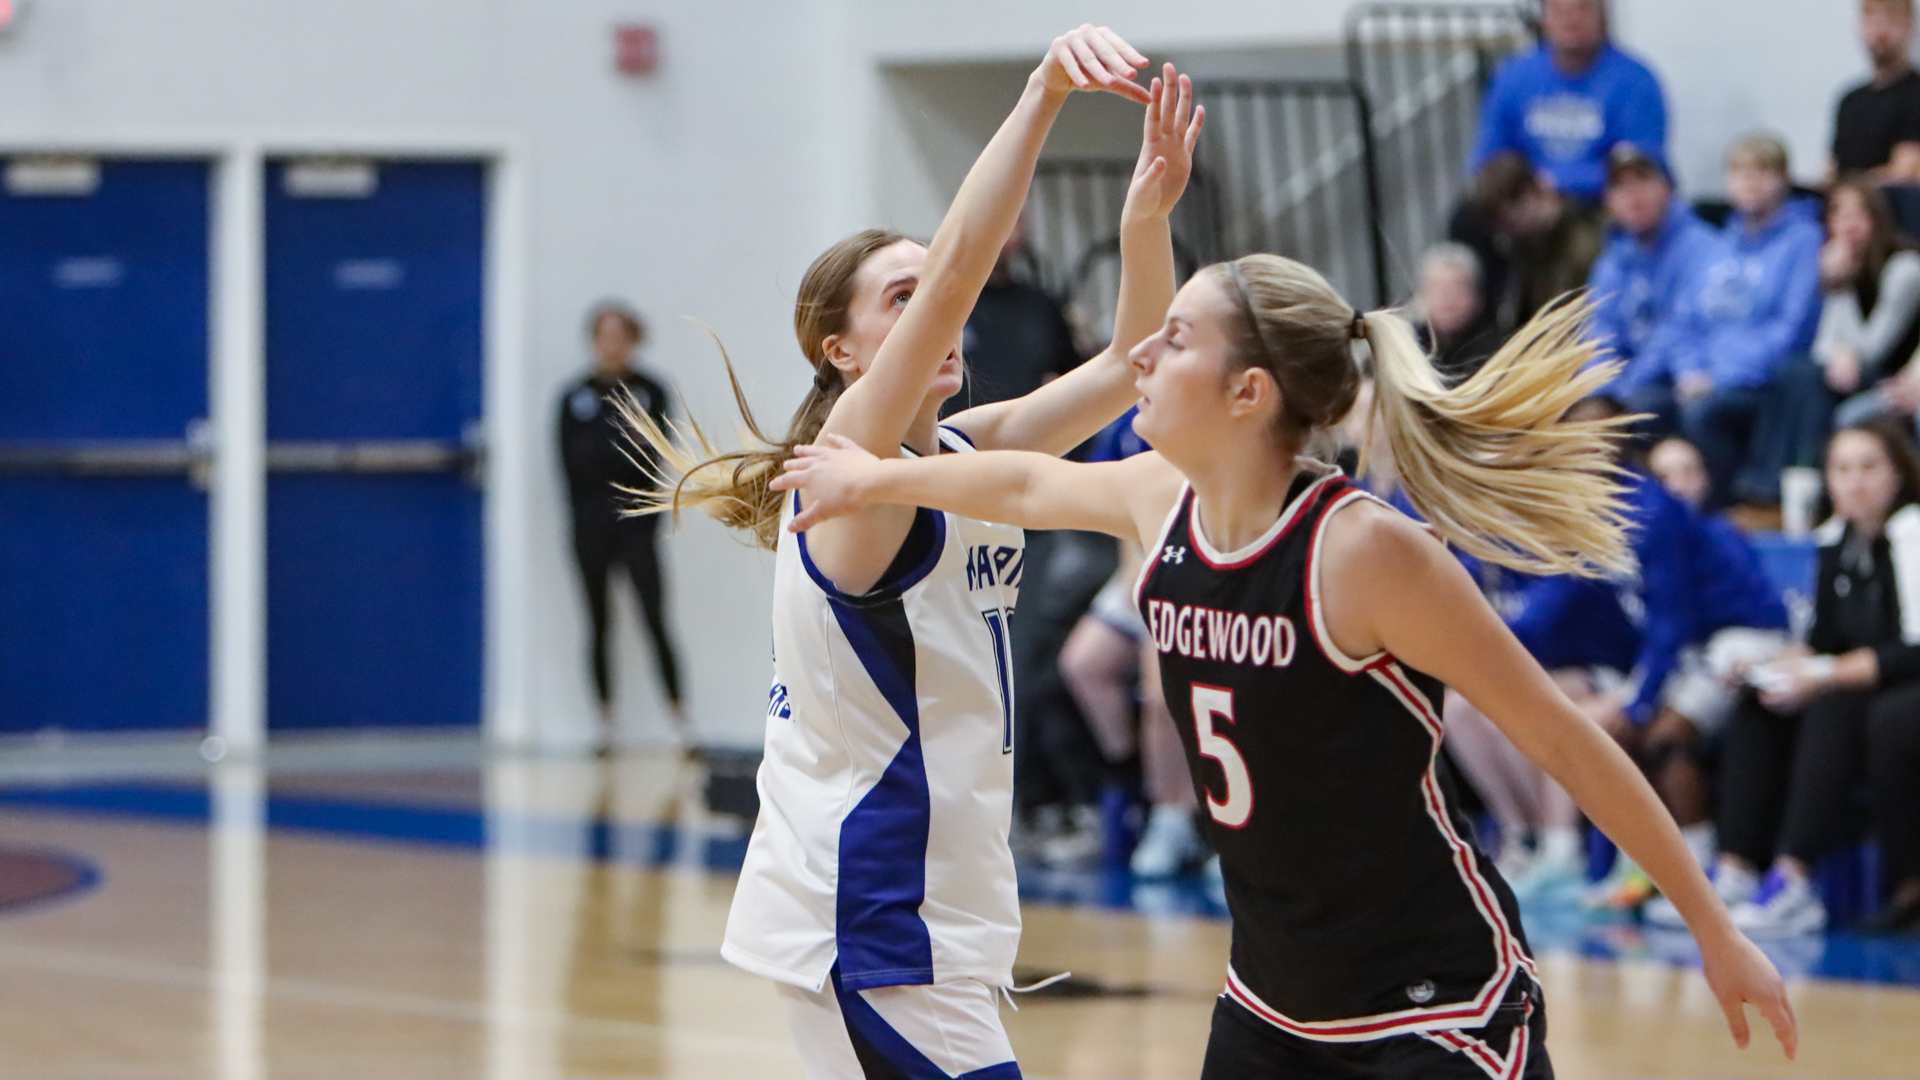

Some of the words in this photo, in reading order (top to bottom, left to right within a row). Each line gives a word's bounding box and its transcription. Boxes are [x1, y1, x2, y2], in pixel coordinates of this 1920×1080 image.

[981, 608, 1015, 754] 1
[1148, 599, 1297, 667] EDGEWOOD
[1191, 681, 1255, 829] 5
